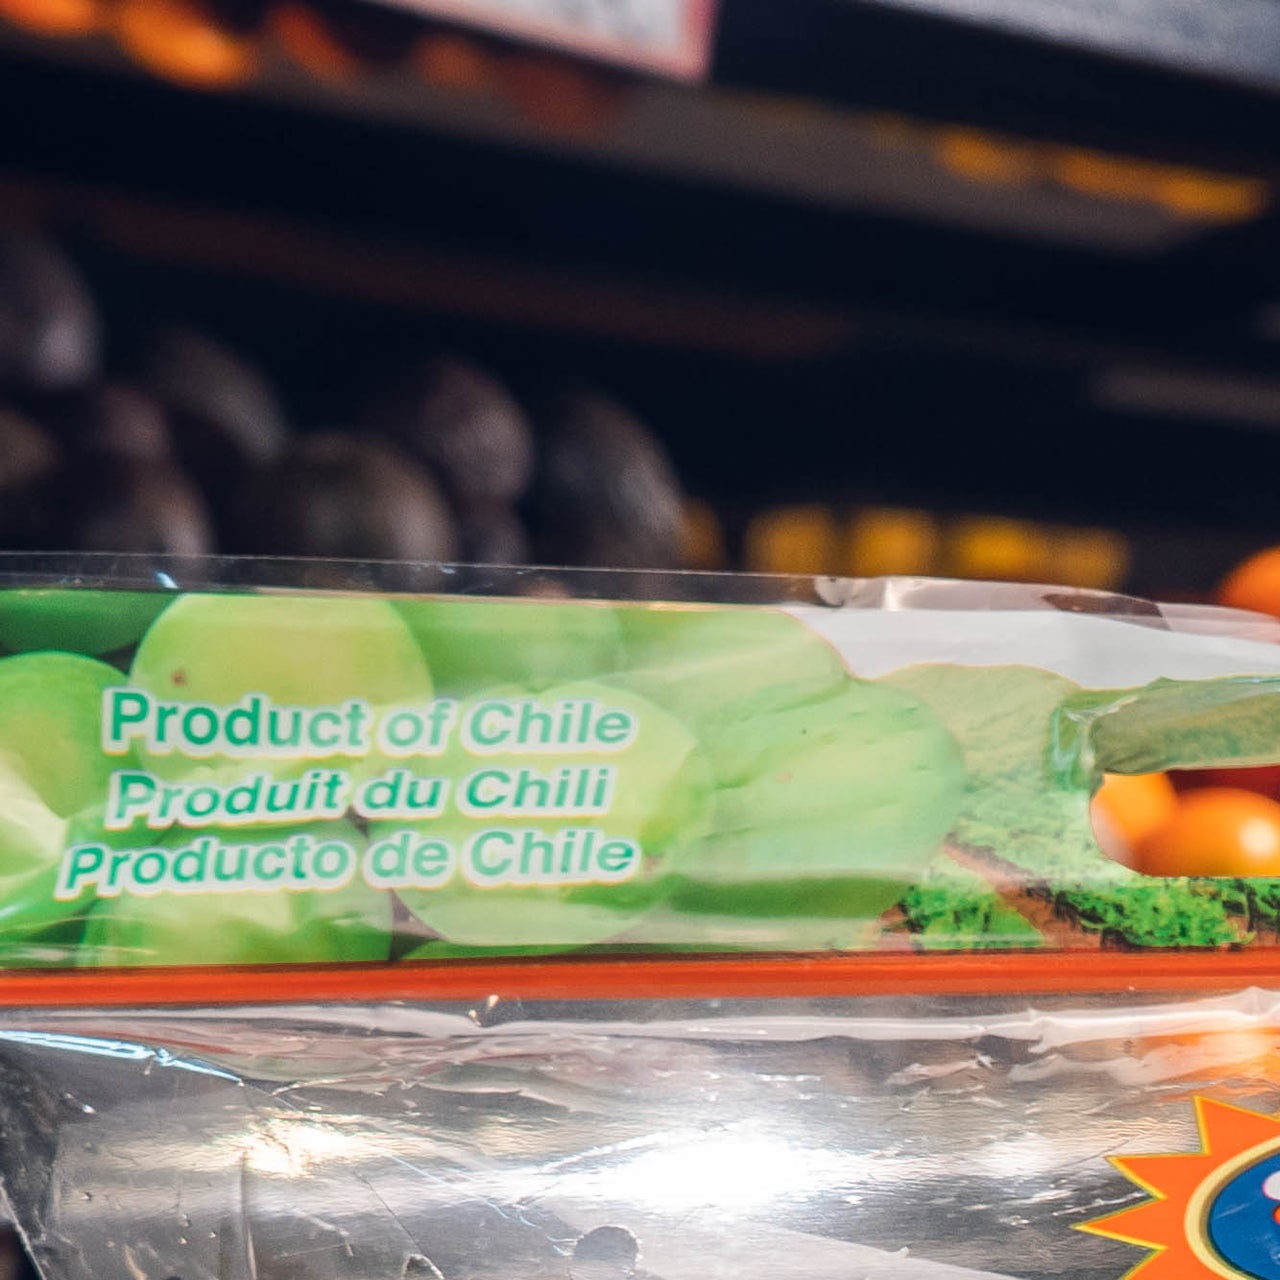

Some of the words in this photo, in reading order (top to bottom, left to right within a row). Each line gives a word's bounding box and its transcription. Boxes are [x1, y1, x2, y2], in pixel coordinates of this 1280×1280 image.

[110, 692, 365, 747] Product
[387, 700, 452, 747] of
[470, 701, 633, 747] Chile
[115, 770, 342, 820] Produit
[363, 771, 442, 809] du
[466, 768, 609, 810] Chili
[65, 836, 351, 891] Producto
[371, 833, 450, 878] de
[470, 830, 634, 877] Chile
